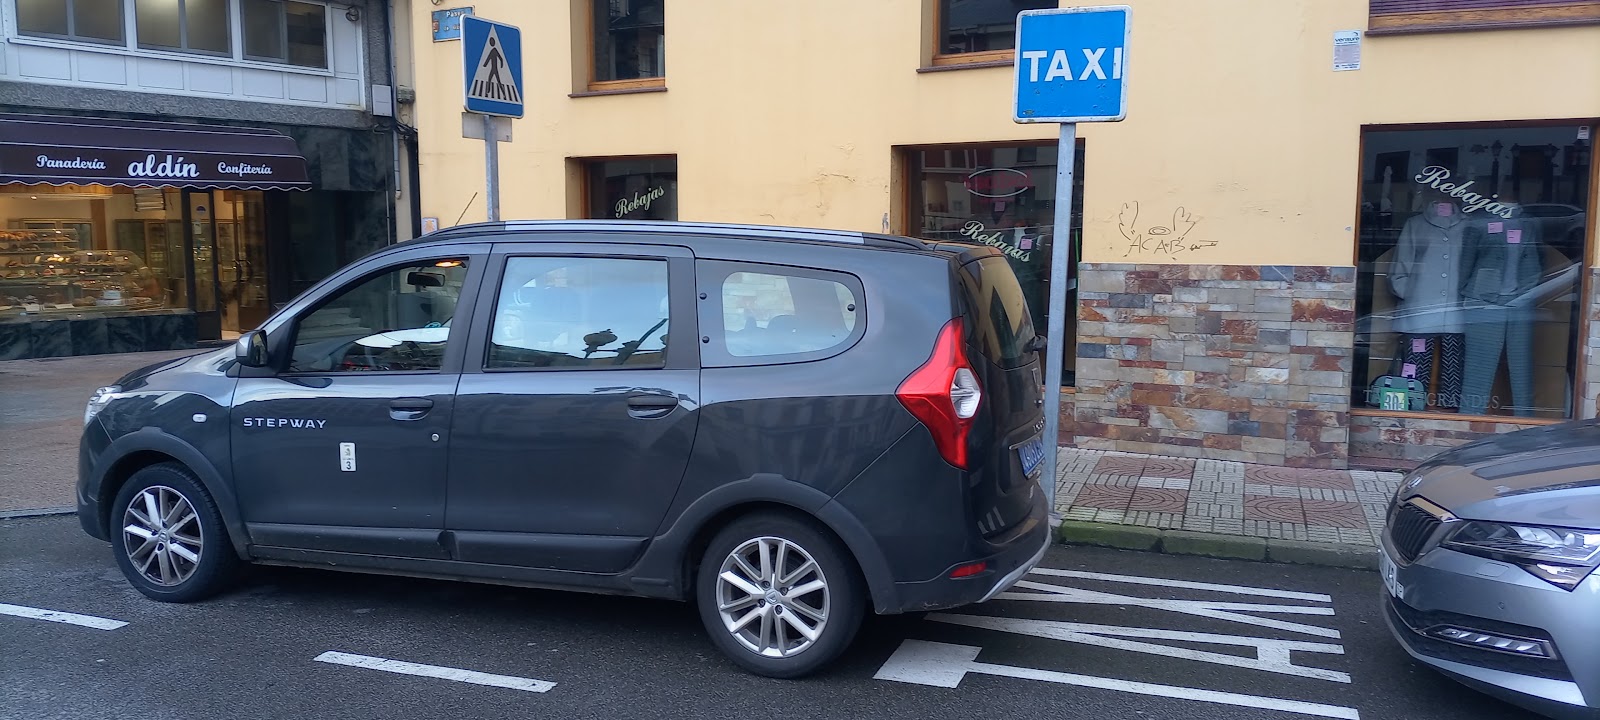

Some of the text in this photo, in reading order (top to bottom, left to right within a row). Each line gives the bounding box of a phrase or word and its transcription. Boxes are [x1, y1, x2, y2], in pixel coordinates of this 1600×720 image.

[1022, 46, 1122, 83] TAXI
[36, 153, 273, 178] Panadería aldín Confitería
[615, 185, 665, 219] Rebajas
[1414, 165, 1514, 220] Rebajas
[243, 417, 327, 429] STEPWAY
[346, 460, 352, 470] 3
